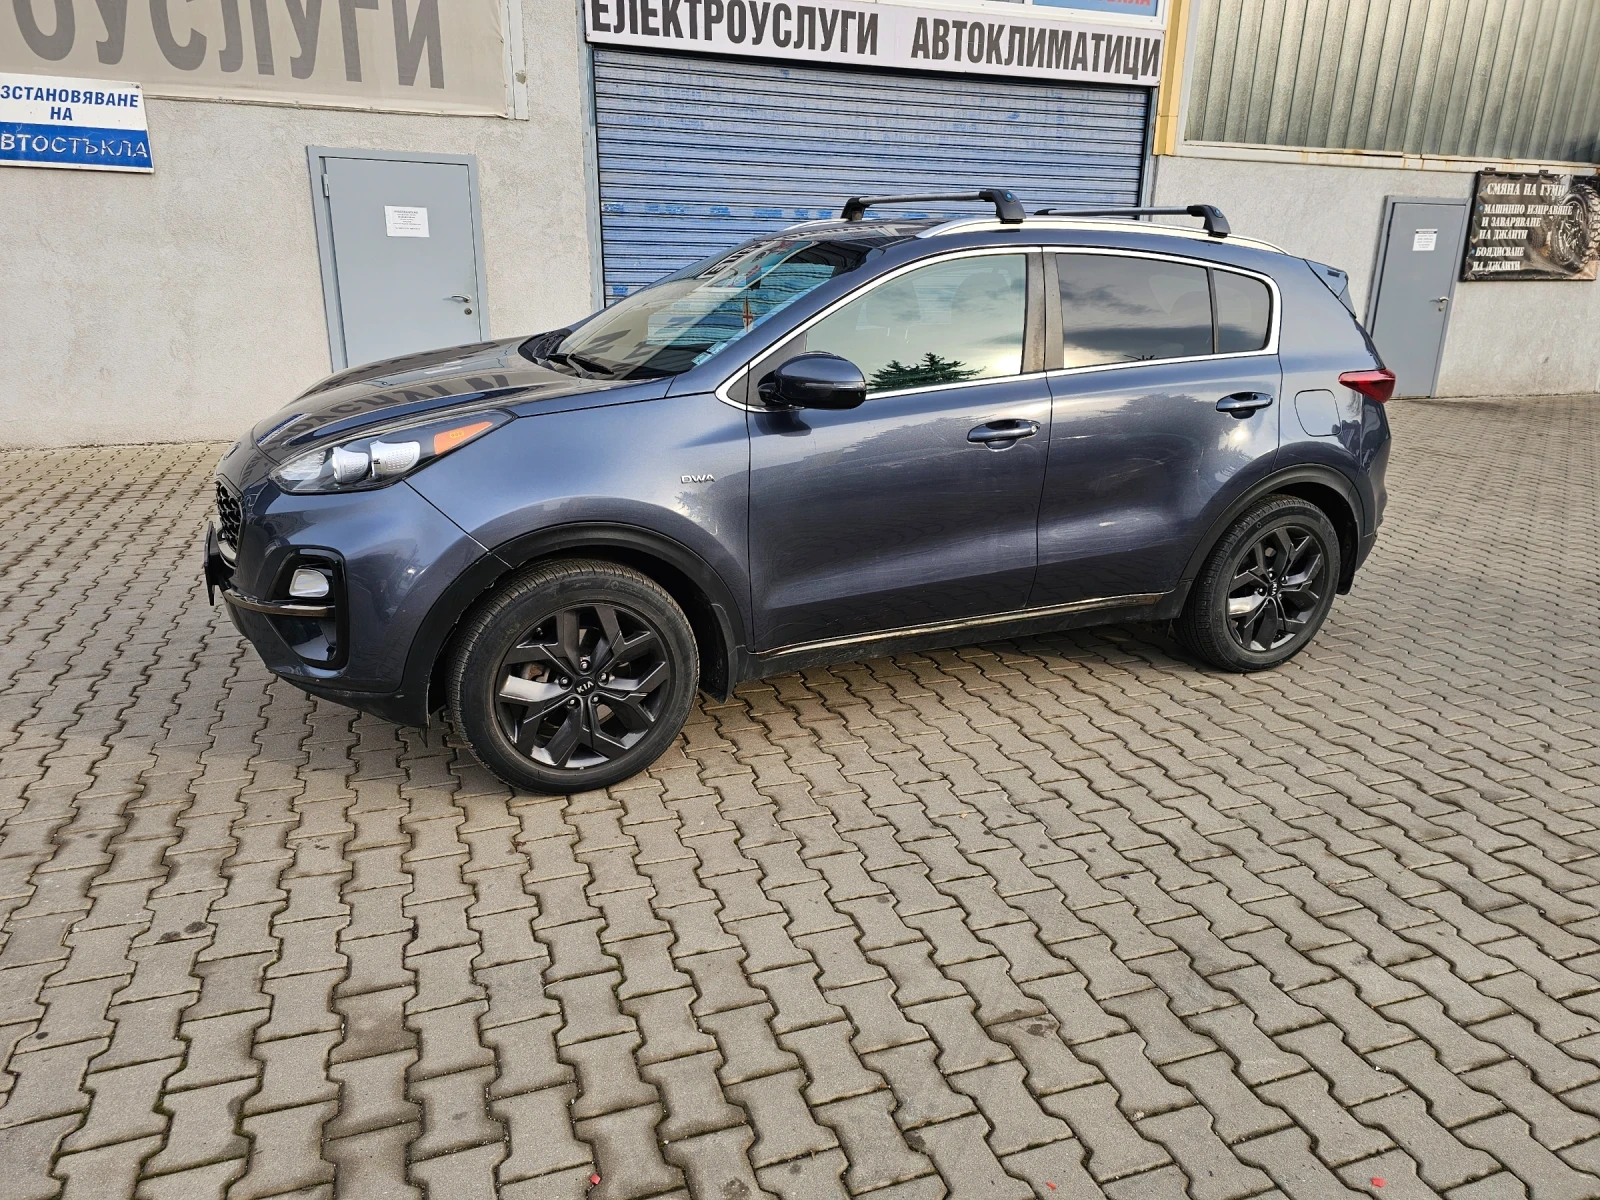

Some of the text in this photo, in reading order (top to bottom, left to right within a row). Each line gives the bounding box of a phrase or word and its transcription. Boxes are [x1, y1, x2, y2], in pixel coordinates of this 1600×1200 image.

[591, 0, 1161, 81] ЕЛЕКТРОУСЛУГИ АВТОКЛИМАТИЦИ
[0, 85, 139, 108] ЗСТАНОВЯВАНЕ
[50, 106, 73, 121] НА
[0, 133, 148, 158] ВТОСТЪКЛА
[1486, 183, 1566, 197] СМЯНА НА ГУМИ
[1483, 204, 1573, 216] МАШИННО ИЗПРАВЯНЕ
[1481, 217, 1542, 228] И ЗАВАРЯВАНЕ
[1479, 229, 1528, 241] НА ДЖАНТИ
[1475, 247, 1525, 258] БОЯДИСВАНЕ
[1472, 260, 1521, 272] НА ДЖАНТИ
[681, 474, 716, 484] DWA
[576, 680, 594, 693] KIA
